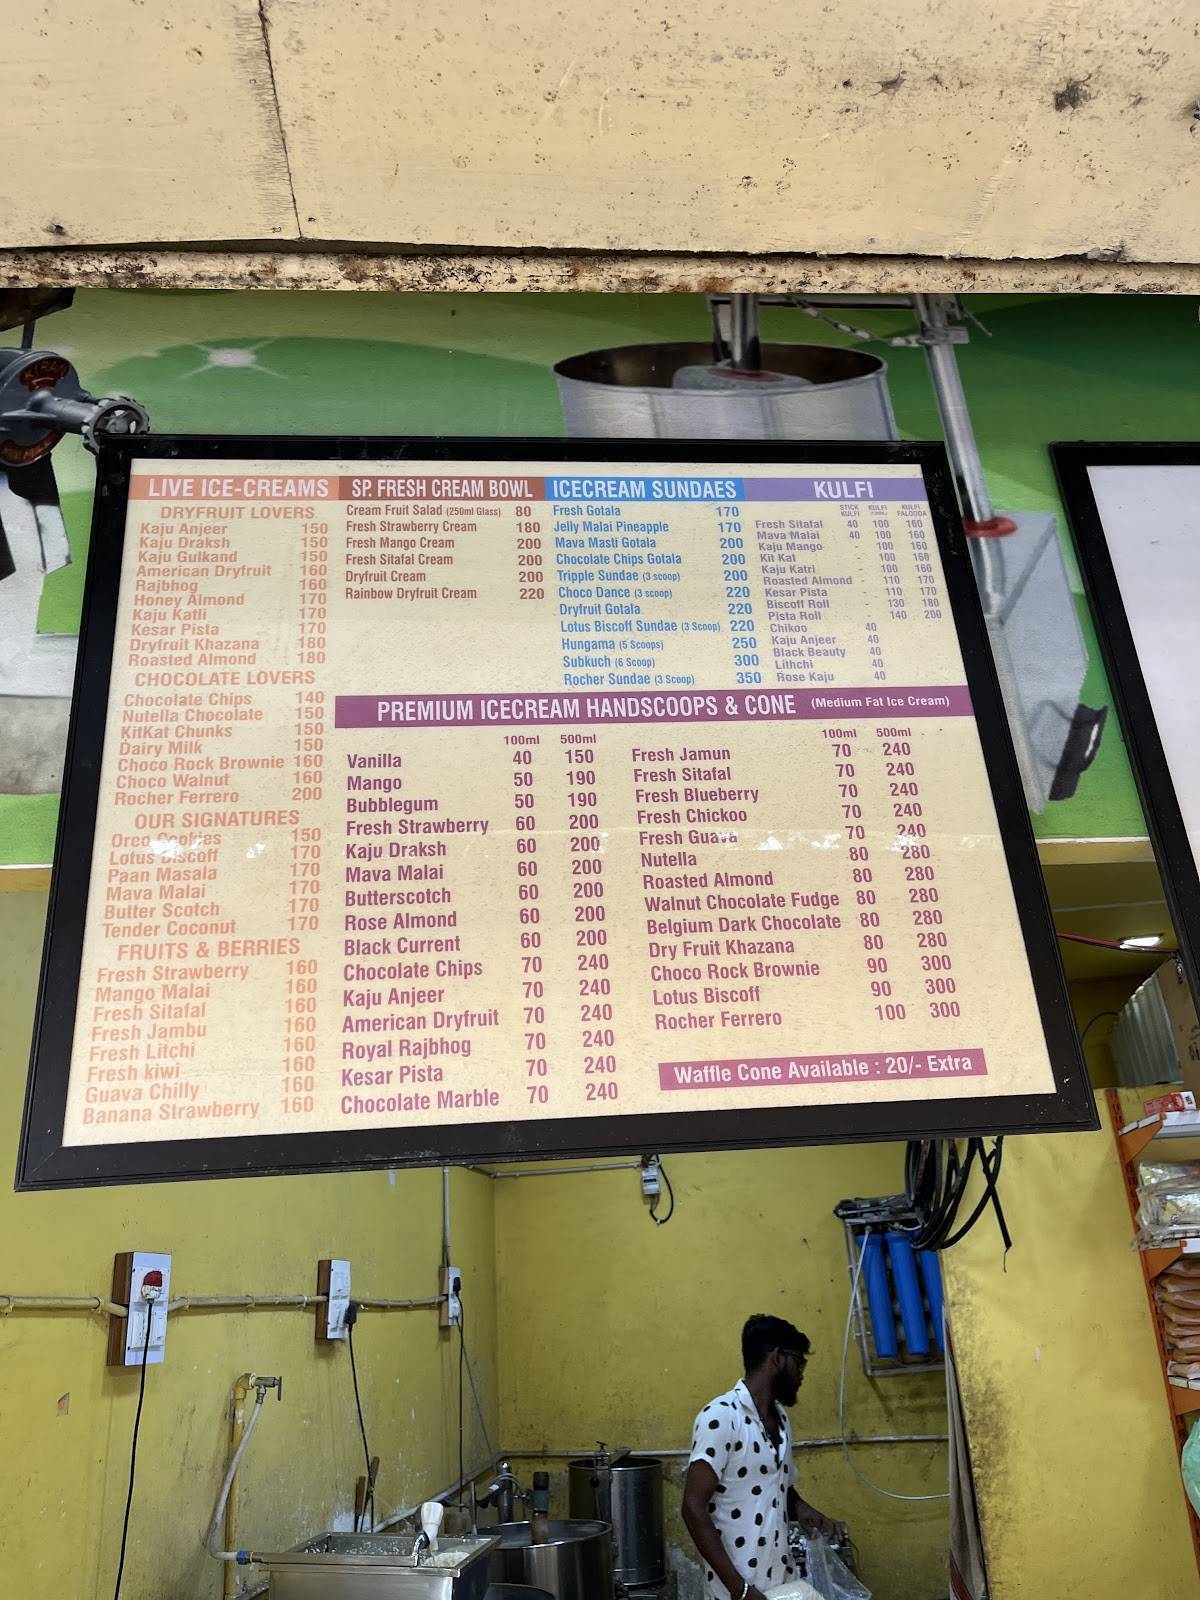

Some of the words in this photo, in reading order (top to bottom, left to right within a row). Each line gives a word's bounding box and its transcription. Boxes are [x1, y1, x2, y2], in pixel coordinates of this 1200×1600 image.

[148, 478, 194, 496] LIVE
[201, 478, 328, 497] ICE-CREAMS
[352, 478, 372, 497] SP.
[377, 478, 426, 497] FRESH
[431, 478, 484, 497] CREAM
[488, 479, 533, 498] BOWL
[553, 479, 646, 498] ICECREAM
[651, 480, 736, 498] SUNDAES
[813, 480, 874, 498] KULFI
[160, 506, 246, 519] DRYFRUIT
[250, 506, 315, 519] LOVERS
[346, 504, 381, 516] Cream
[385, 504, 409, 515] Fruit
[412, 504, 442, 515] Salad
[446, 507, 474, 517] (250ml
[476, 506, 501, 518] Glass)
[515, 505, 532, 517] 80
[140, 522, 174, 536] Kaju
[178, 523, 228, 536] Anjeer
[301, 522, 328, 534] 150
[553, 520, 579, 534] Jelly
[582, 520, 613, 532] Malai
[616, 520, 669, 534] Pineapple
[717, 522, 741, 533] 170
[754, 520, 785, 529] Fresh
[788, 519, 823, 528] Sitafal
[847, 519, 858, 528] 40
[872, 519, 890, 528] 100
[905, 519, 923, 528] 160
[346, 536, 376, 548] Fresh
[379, 536, 416, 550] Mango
[419, 536, 455, 548] Cream
[516, 538, 542, 549] 200
[556, 553, 610, 565] Chocolate
[613, 553, 644, 567] Chips
[647, 552, 682, 564] Gotala
[721, 553, 745, 565] 200
[136, 564, 209, 577] American
[214, 564, 272, 578] Dryfruit
[299, 564, 327, 576] 160
[761, 564, 786, 575] Kaju
[789, 564, 816, 574] Katri
[880, 563, 898, 573] 100
[915, 563, 932, 572] 160
[345, 587, 393, 599] Rainbow
[396, 587, 439, 601] Dryfruit
[441, 586, 477, 599] Cream
[519, 587, 544, 600] 220
[768, 611, 796, 620] Pista
[799, 610, 821, 620] Roll
[889, 610, 907, 620] 140
[923, 609, 942, 619] 200
[560, 620, 591, 632] Lotus
[594, 619, 632, 632] Biscoff
[636, 619, 678, 632] Sundae
[681, 622, 689, 632] (3
[691, 621, 720, 632] Scoop)
[729, 619, 754, 631] 220
[129, 638, 189, 652] Dryfruit
[194, 638, 260, 650] Khazana
[297, 636, 326, 649] 180
[772, 647, 805, 657] Black
[807, 647, 846, 658] Beauty
[869, 646, 881, 656] 40
[134, 671, 240, 687] CHOCOLATE
[247, 670, 315, 685] LOVERS
[124, 693, 202, 707] Chocolate
[208, 692, 252, 707] Chips
[296, 690, 325, 704] 140
[378, 700, 473, 721] PREMIUM
[480, 698, 580, 720] ICECREAM
[586, 695, 718, 717] HANDSCOOPS
[725, 695, 738, 715] &
[744, 694, 796, 715] CONE
[811, 697, 862, 710] (Medium
[865, 696, 884, 706] Fat
[886, 696, 904, 706] Ice
[907, 695, 949, 707] Cream)
[503, 735, 540, 745] 100ml
[560, 733, 596, 744] 500ml
[821, 728, 857, 738] 100ml
[876, 727, 911, 737] 500ml
[346, 753, 402, 768] Vanilla
[512, 750, 532, 765] 40
[564, 748, 594, 764] 150
[631, 747, 674, 762] Fresh
[679, 747, 731, 761] Jamun
[831, 743, 852, 757] 70
[882, 742, 911, 756] 240
[114, 791, 174, 805] Rocher
[179, 790, 239, 804] Ferrero
[291, 786, 322, 800] 200
[635, 788, 679, 803] Fresh
[684, 787, 759, 803] Blueberry
[838, 783, 858, 798] 70
[889, 782, 918, 796] 240
[134, 813, 174, 829] OUR
[181, 809, 300, 828] SIGNATURES
[346, 819, 392, 836] Fresh
[398, 817, 489, 836] Strawberry
[515, 815, 536, 831] 60
[569, 813, 598, 830] 200
[108, 869, 150, 884] Paan
[156, 865, 217, 882] Masala
[290, 862, 320, 877] 170
[643, 872, 708, 890] Roasted
[713, 870, 774, 887] Almond
[852, 867, 872, 883] 80
[904, 865, 934, 881] 280
[102, 922, 160, 938] Tender
[167, 919, 236, 936] Coconut
[287, 915, 319, 931] 170
[646, 918, 713, 937] Belgium
[718, 916, 757, 932] Dark
[761, 914, 841, 931] Chocolate
[859, 911, 880, 928] 80
[912, 909, 943, 925] 280
[118, 942, 188, 960] FRUITS
[196, 941, 210, 958] &
[218, 937, 300, 957] BERRIES
[344, 938, 391, 956] Black
[396, 935, 461, 954] Current
[520, 931, 541, 949] 60
[576, 929, 607, 946] 200
[342, 1013, 426, 1033] American
[433, 1009, 499, 1031] Dryfruit
[523, 1006, 545, 1024] 70
[580, 1003, 613, 1021] 240
[655, 1012, 715, 1030] Rocher
[720, 1010, 782, 1027] Ferrero
[874, 1003, 906, 1020] 100
[929, 1001, 960, 1018] 300
[674, 1065, 731, 1083] Waffle
[737, 1063, 782, 1081] Cone
[788, 1059, 869, 1078] Available
[875, 1062, 880, 1074] :
[885, 1056, 921, 1075] 20/-
[926, 1054, 972, 1071] Extra
[341, 1092, 430, 1114] Chocolate
[437, 1088, 500, 1109] Marble
[526, 1084, 549, 1104] 70
[585, 1081, 618, 1101] 240
[82, 1107, 152, 1124] Banana
[159, 1100, 260, 1120] Strawberry
[280, 1096, 314, 1114] 160
